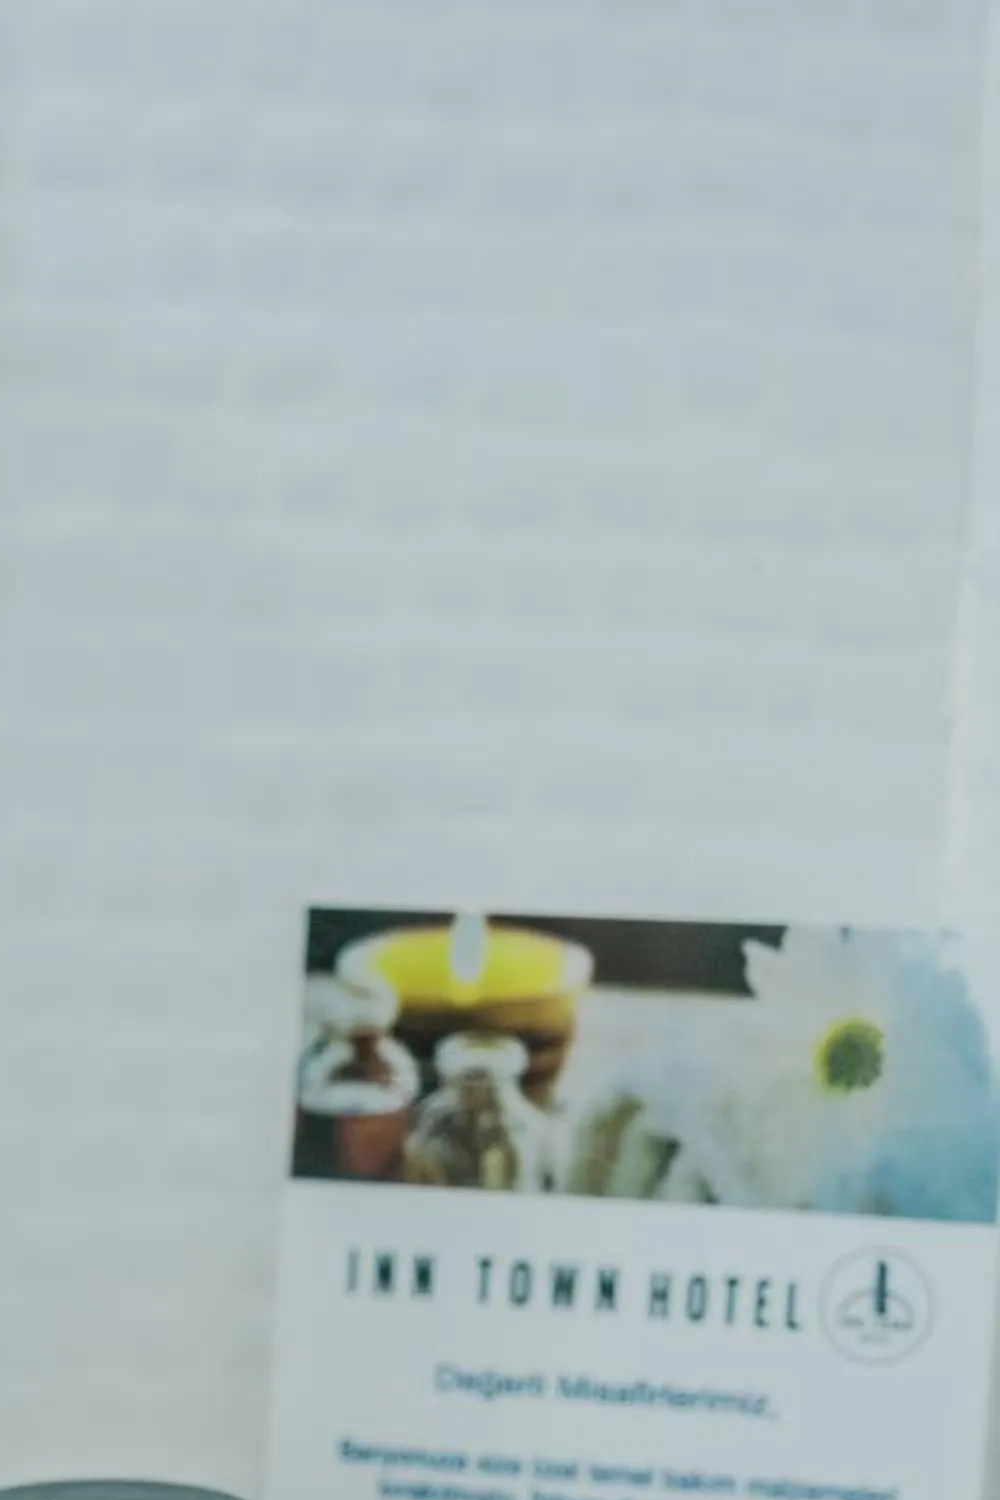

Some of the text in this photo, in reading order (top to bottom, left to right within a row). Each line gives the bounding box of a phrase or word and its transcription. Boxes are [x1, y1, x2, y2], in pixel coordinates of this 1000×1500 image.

[346, 1248, 802, 1332] INN TOWN HOTEL
